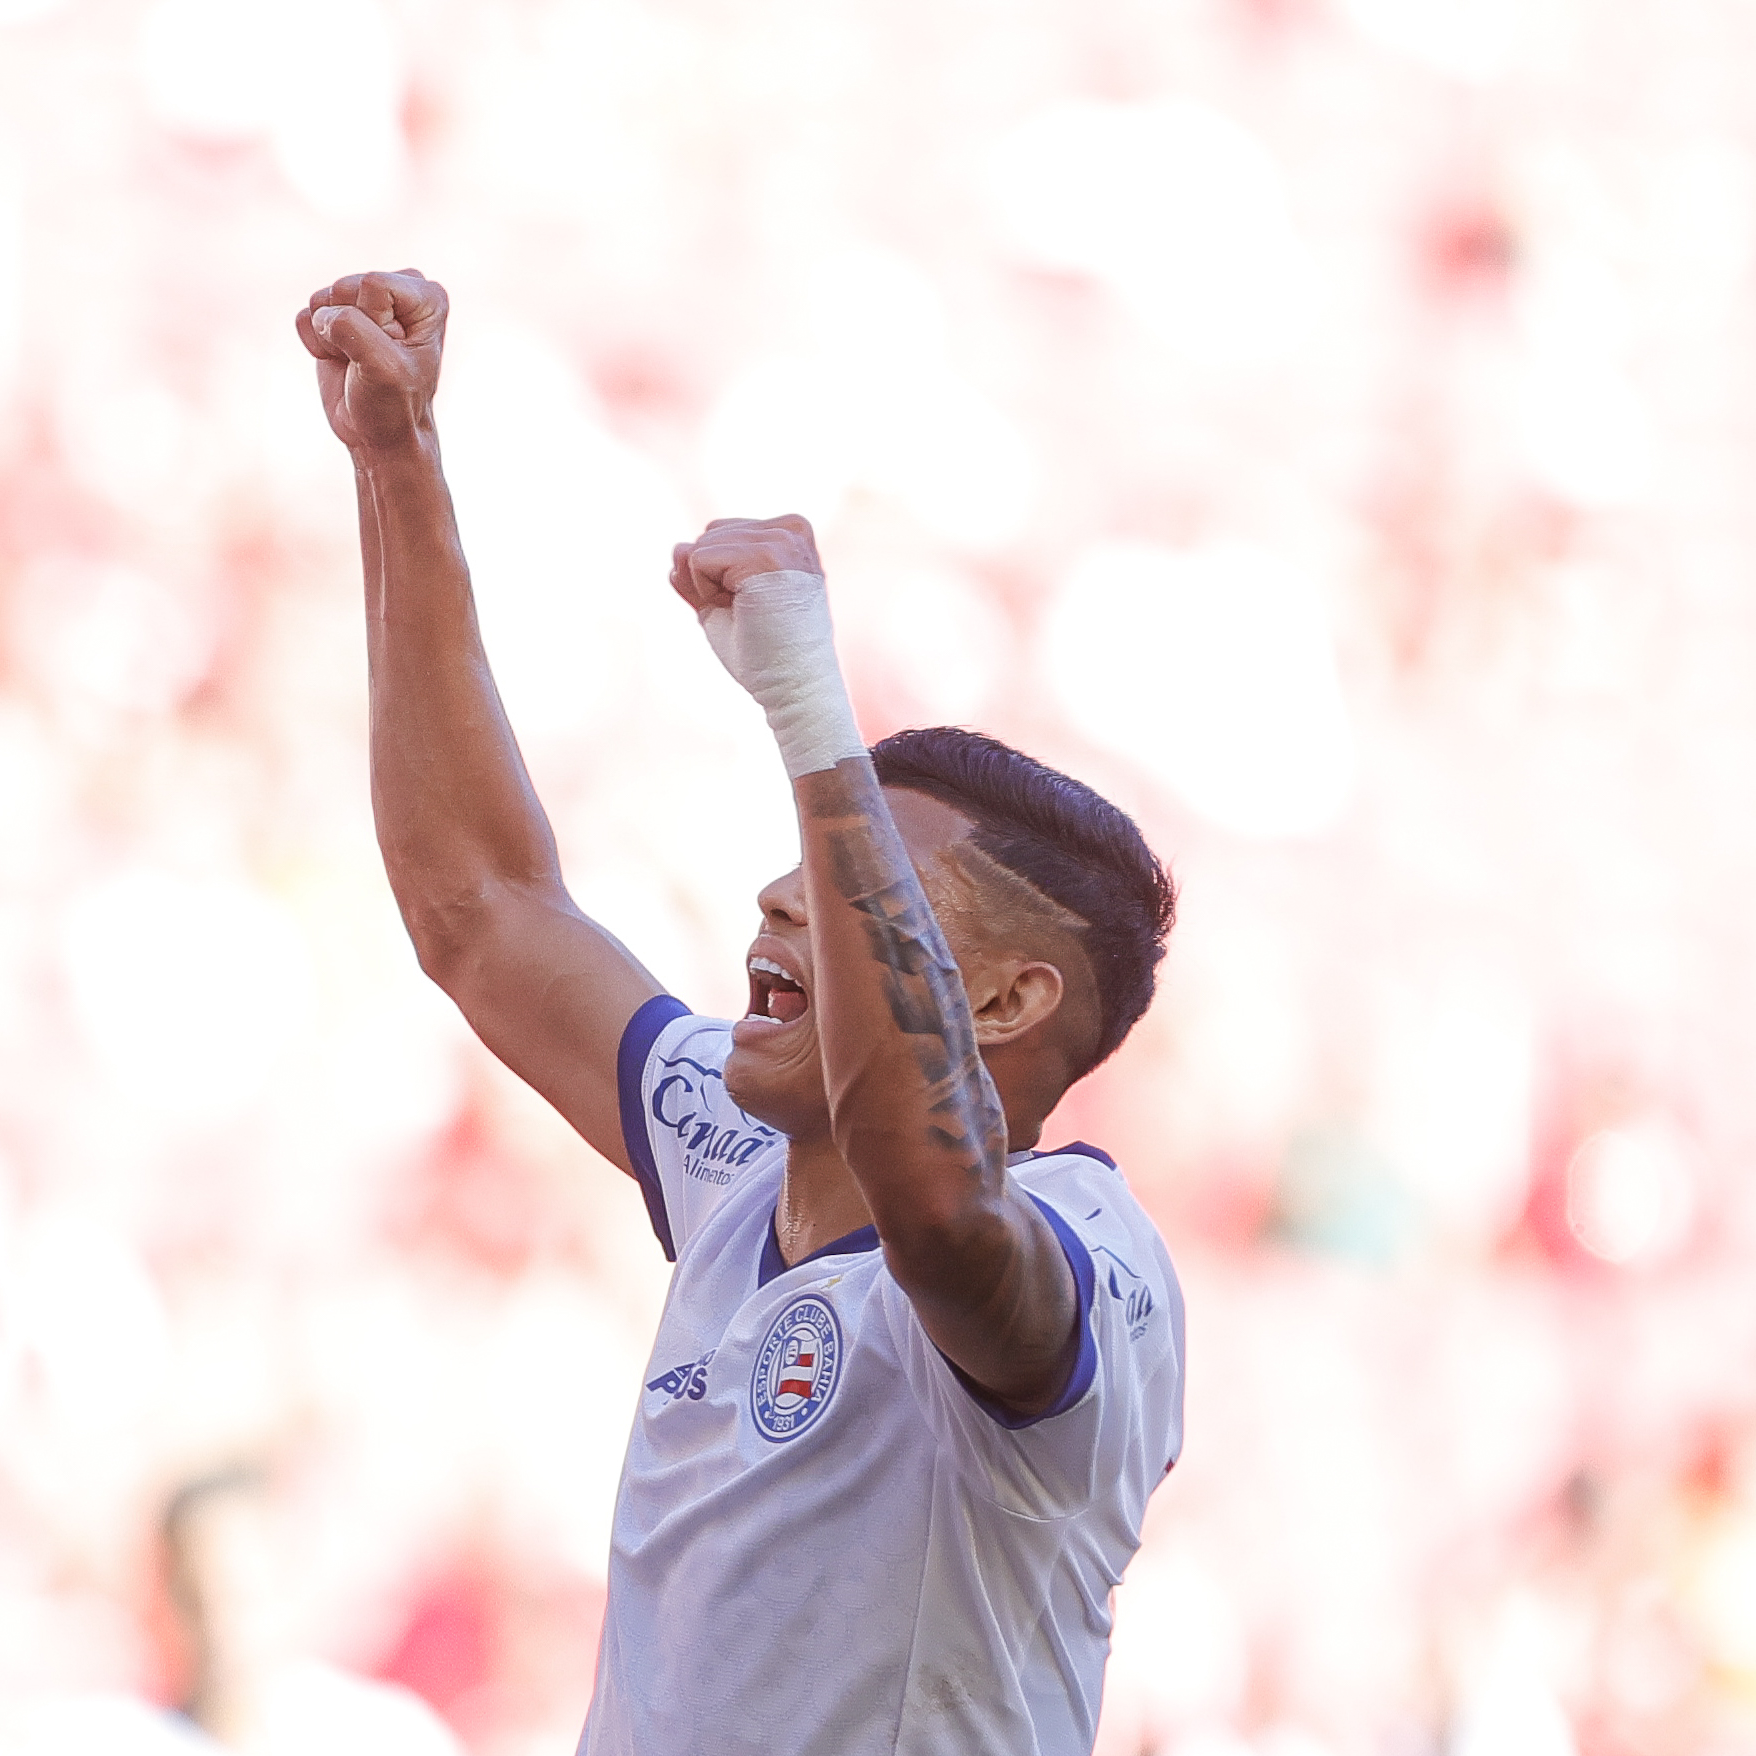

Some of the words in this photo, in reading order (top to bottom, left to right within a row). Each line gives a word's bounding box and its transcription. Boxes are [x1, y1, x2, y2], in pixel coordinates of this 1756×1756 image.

[795, 1305, 832, 1339] CLUBE
[756, 1313, 794, 1407] ESPORTE
[810, 1340, 835, 1404] BAHIA
[772, 1414, 795, 1431] 1931
